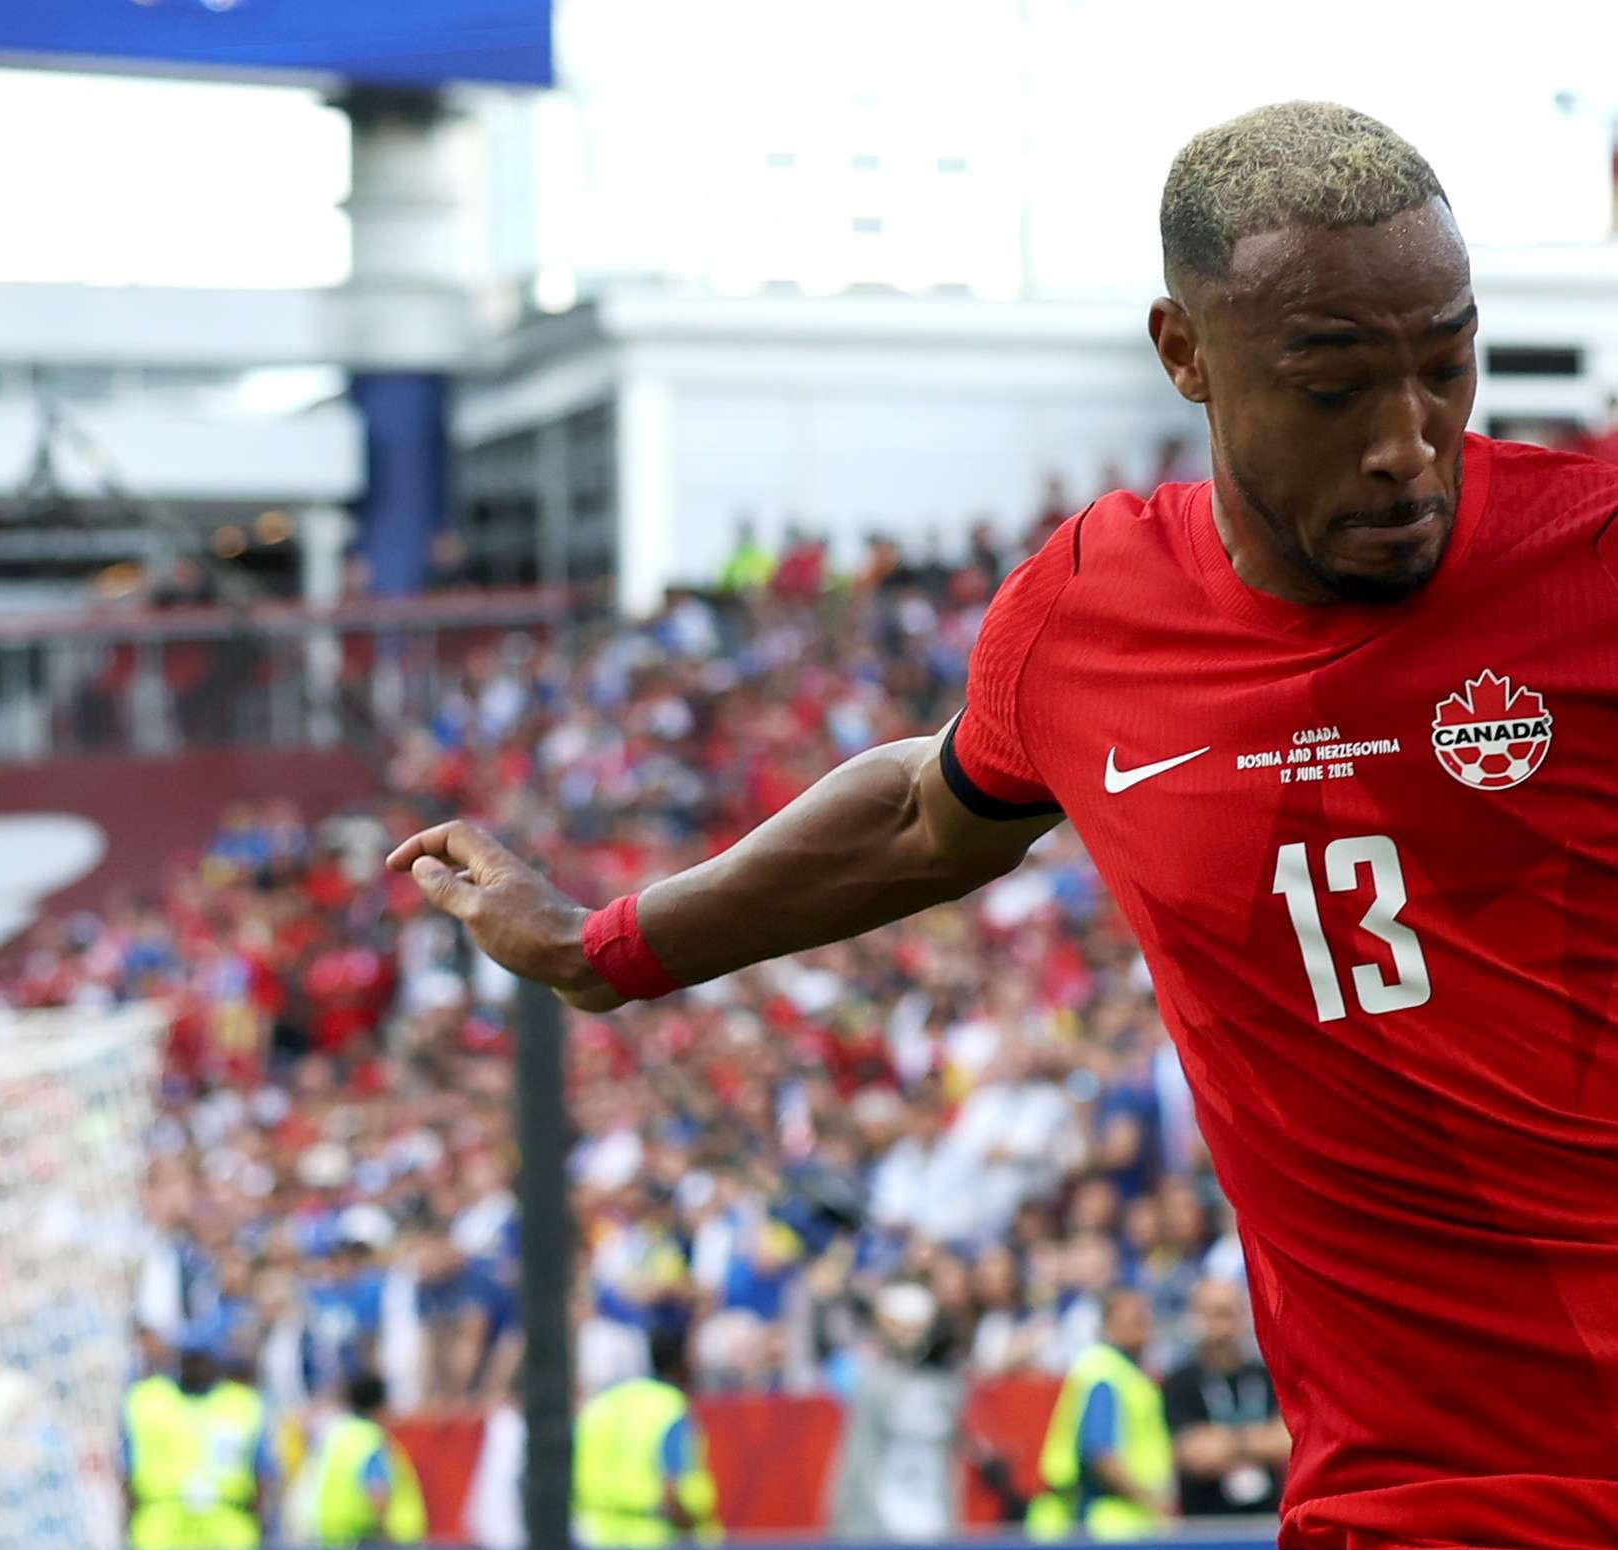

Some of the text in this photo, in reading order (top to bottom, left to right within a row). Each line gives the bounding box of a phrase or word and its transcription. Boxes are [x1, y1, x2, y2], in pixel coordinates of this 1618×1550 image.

[1292, 725, 1342, 745] CANADA
[1435, 721, 1548, 746] CANADA
[1236, 738, 1401, 770] BOSNIA AND HERZEGOVINA
[1280, 762, 1355, 784] 12 JUNE 2026
[1271, 834, 1432, 1024] 13
